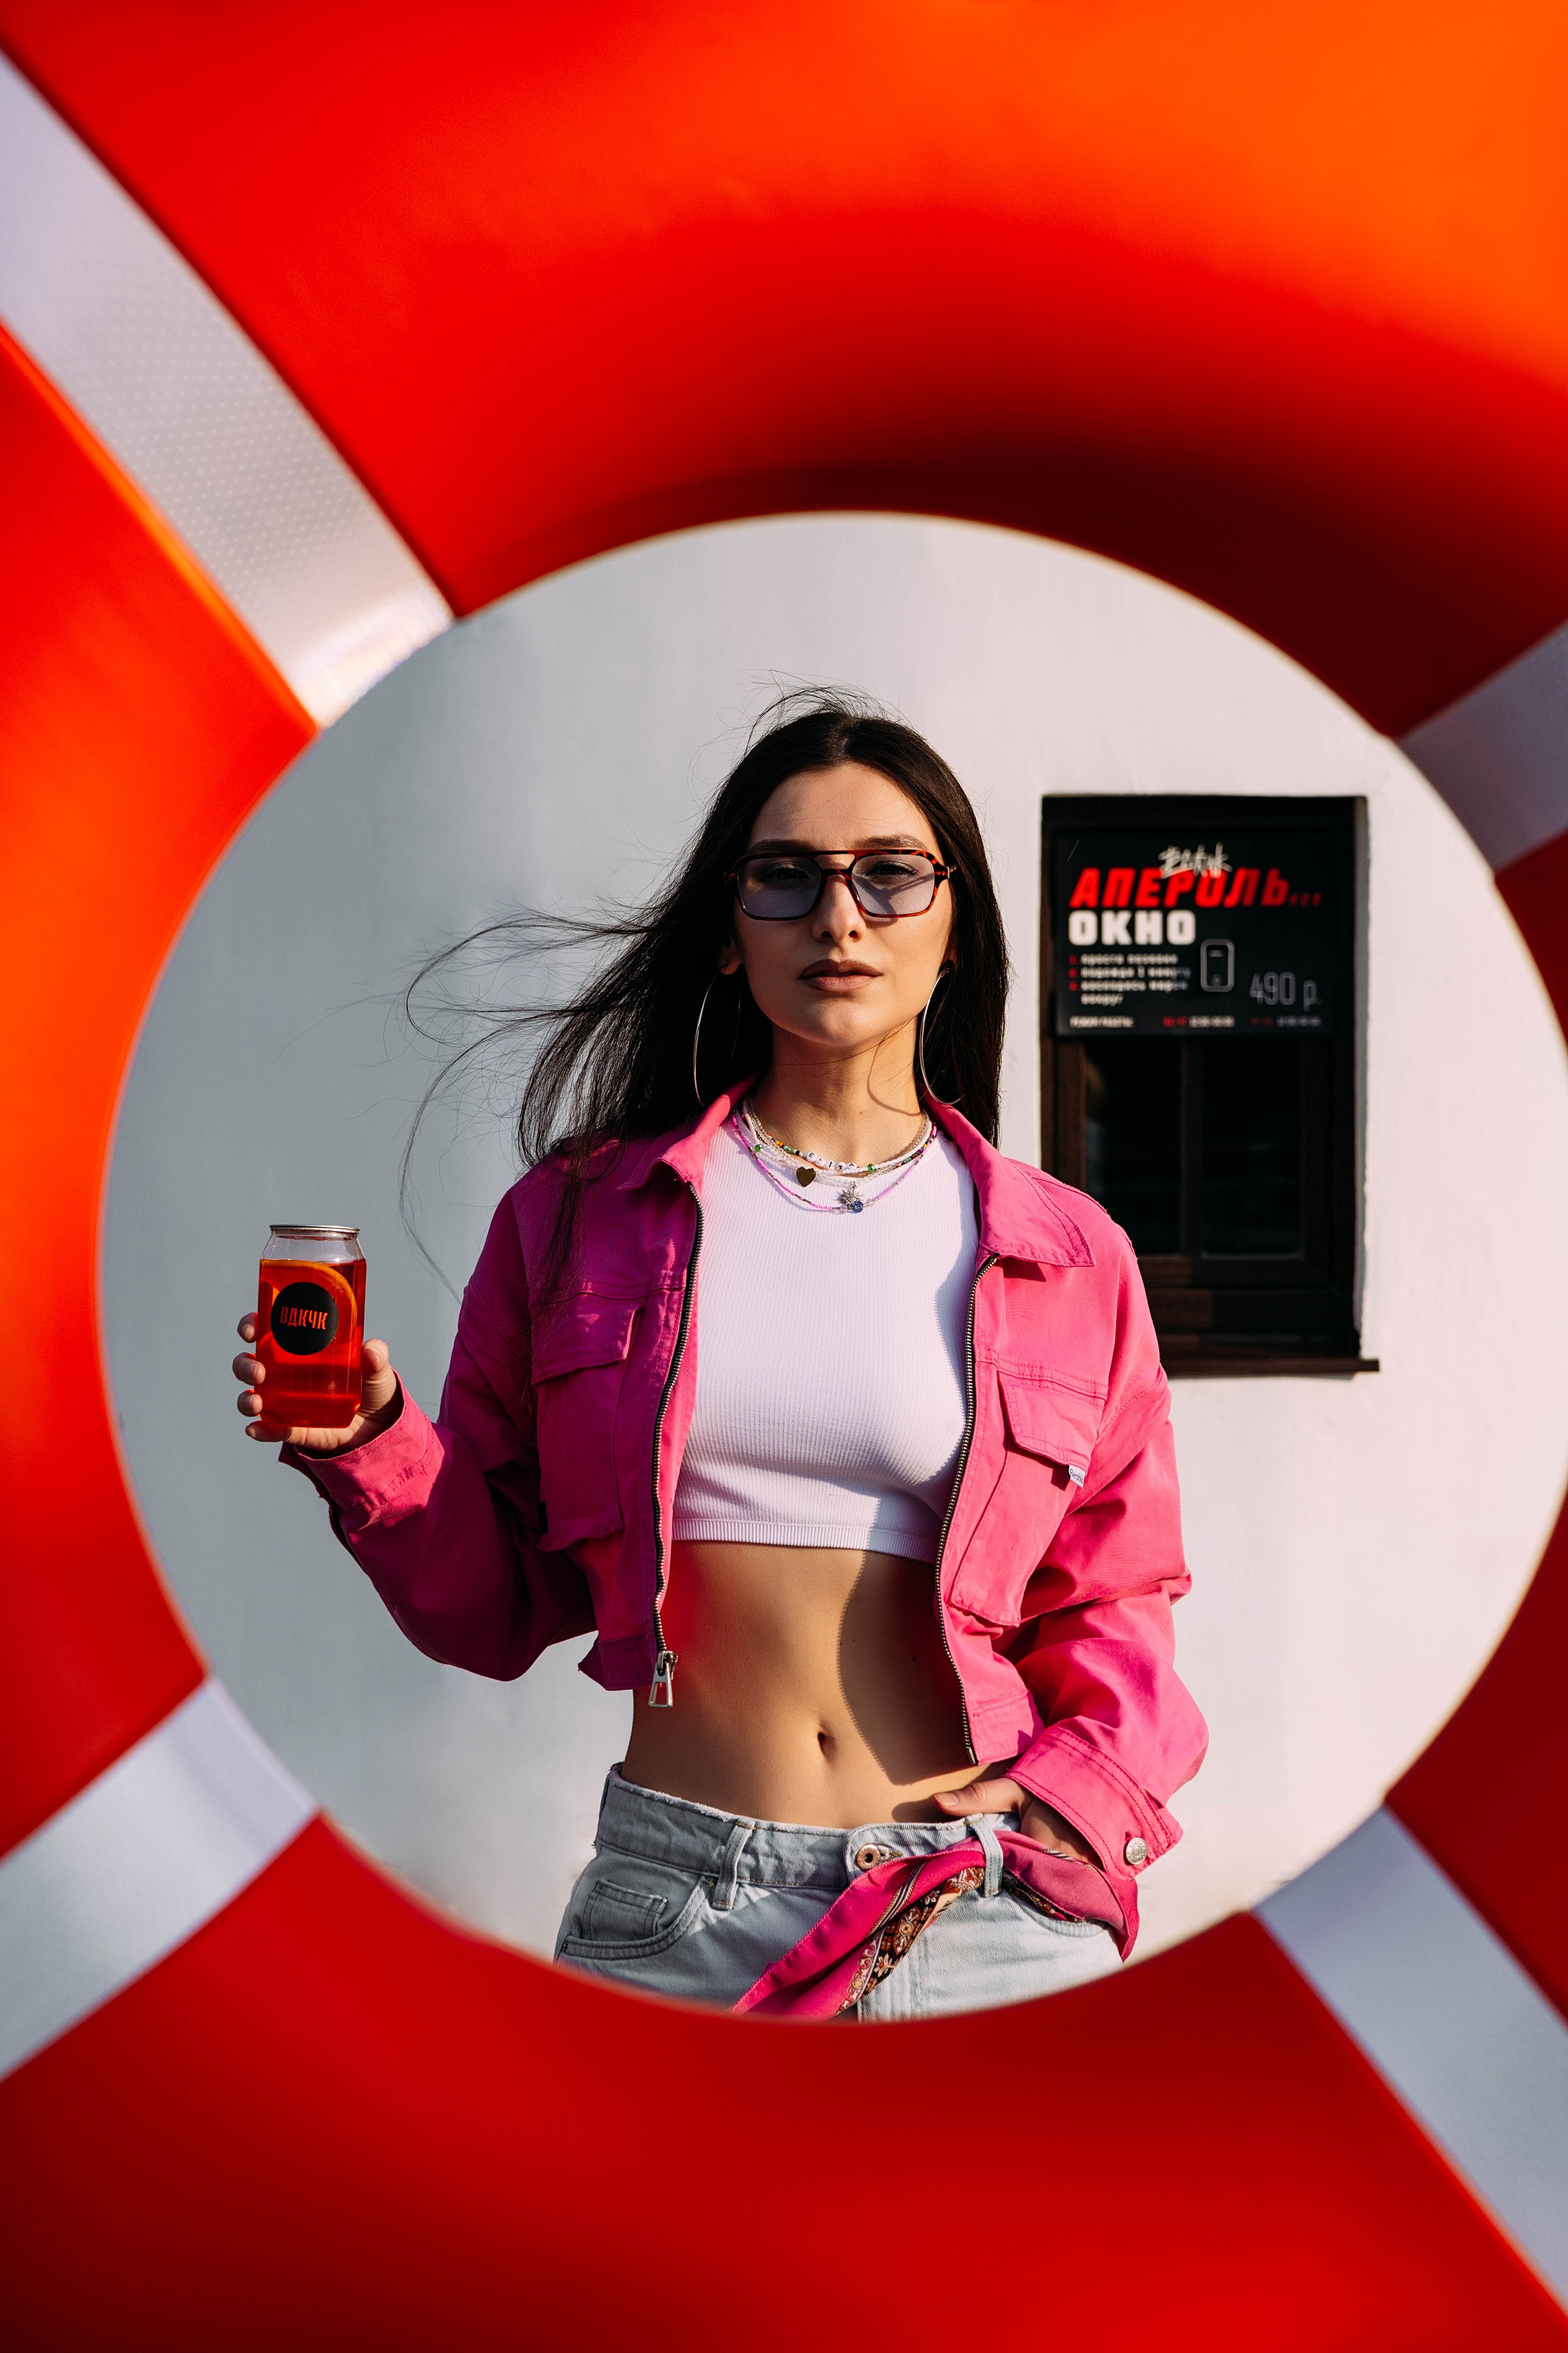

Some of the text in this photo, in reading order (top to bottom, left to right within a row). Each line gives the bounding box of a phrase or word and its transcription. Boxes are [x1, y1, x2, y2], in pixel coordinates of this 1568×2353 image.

[1068, 910, 1196, 945] ОКНО
[1250, 972, 1295, 1005] 490
[809, 1152, 854, 1169] ELITA
[280, 1306, 328, 1330] ВДКЧК
